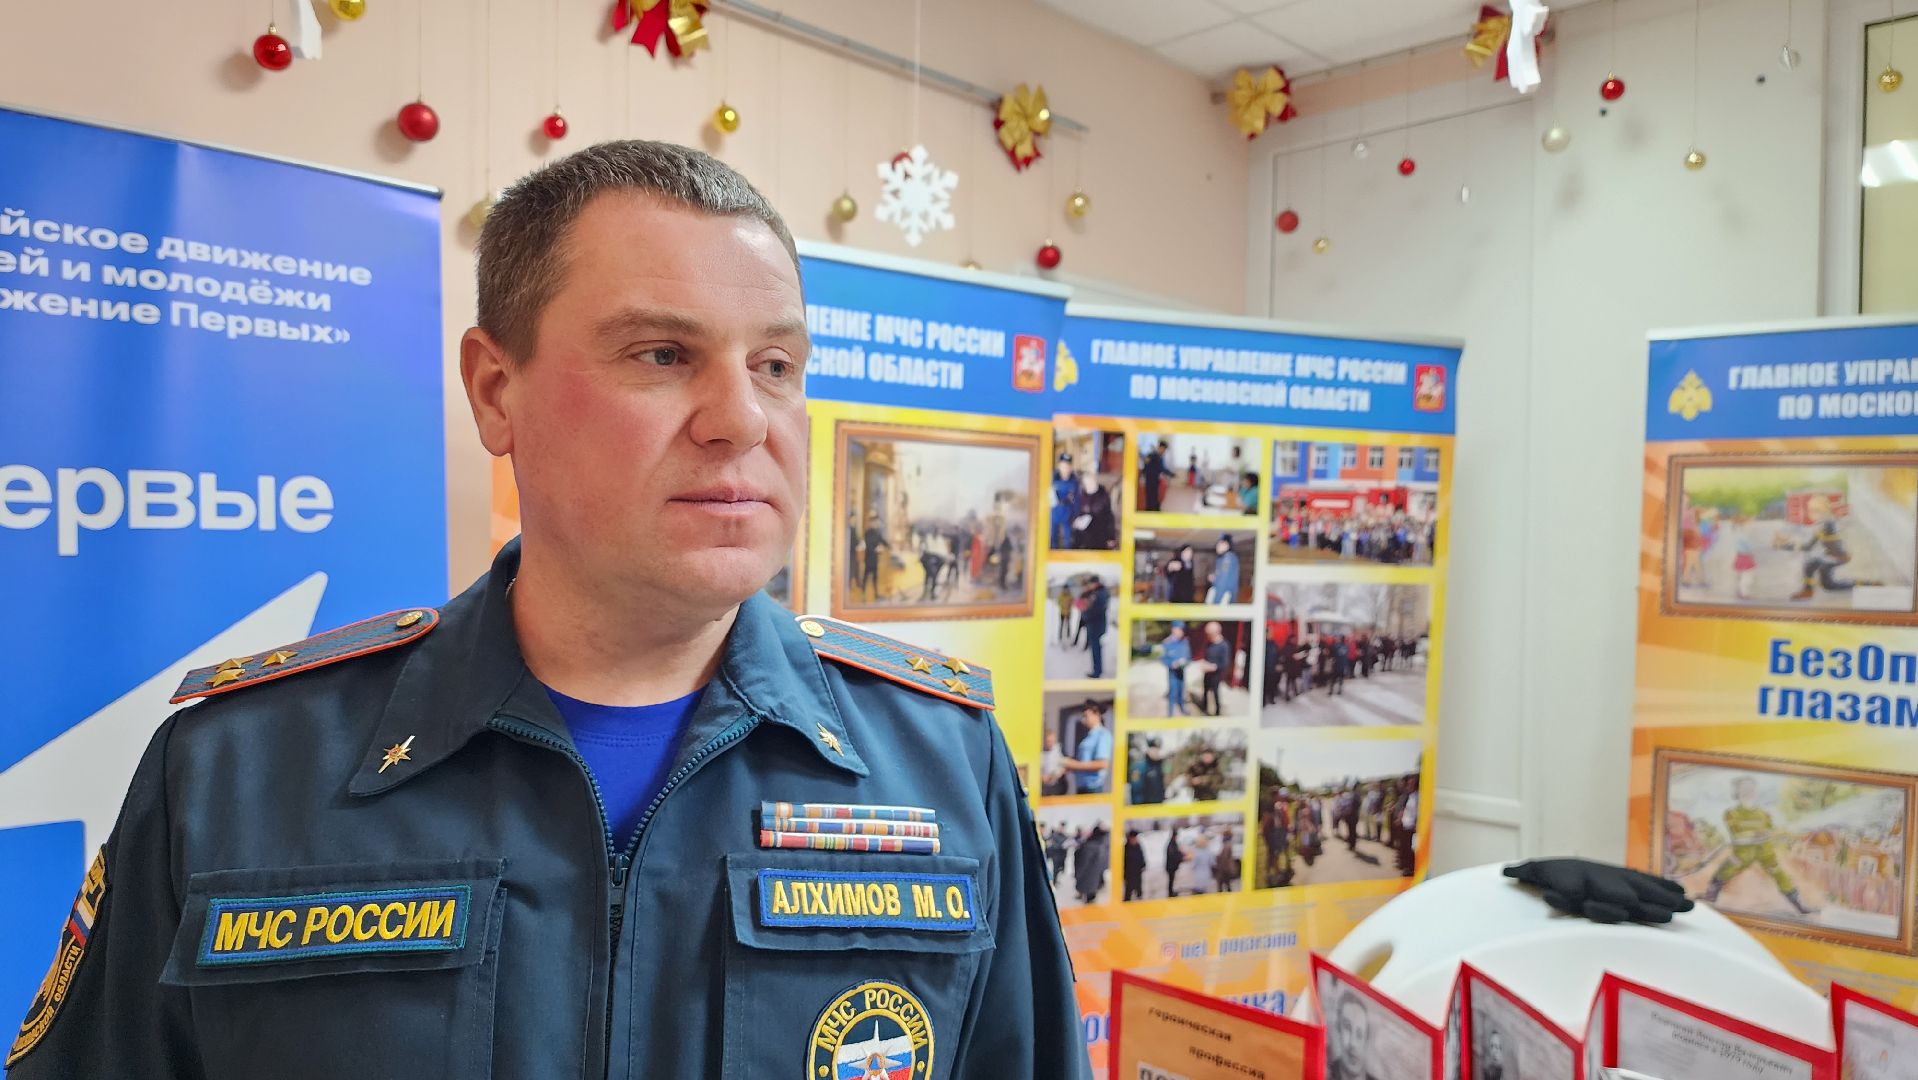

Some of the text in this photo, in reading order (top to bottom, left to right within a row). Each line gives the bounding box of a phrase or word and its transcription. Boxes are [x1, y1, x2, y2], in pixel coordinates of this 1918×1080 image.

[0, 207, 373, 287] йское движение
[61, 261, 91, 284] и
[102, 264, 331, 313] молодёжи
[0, 288, 351, 344] жение Первых»
[874, 313, 924, 348] МЧС
[926, 320, 1006, 358] РОССИИ
[868, 352, 965, 390] ОБЛАСТИ
[1090, 338, 1408, 385] ГЛАВНОЕ УПРАВЛЕНИЕ МЧС РОССИИ
[1728, 361, 1839, 391] ГЛАВНОЕ
[1130, 374, 1372, 412] ПО МОСКОВСКОЙ ОБЛАСТИ
[1778, 390, 1918, 420] ПО МОСКО
[0, 464, 335, 558] ервые
[1769, 639, 1917, 684] БезОп
[772, 880, 970, 919] АЛХИМОВ М. О.
[213, 898, 457, 952] МЧС РОССИИ
[54, 945, 82, 1002] ОБЛАСТИ
[817, 988, 928, 1052] МЧС РОССИИ
